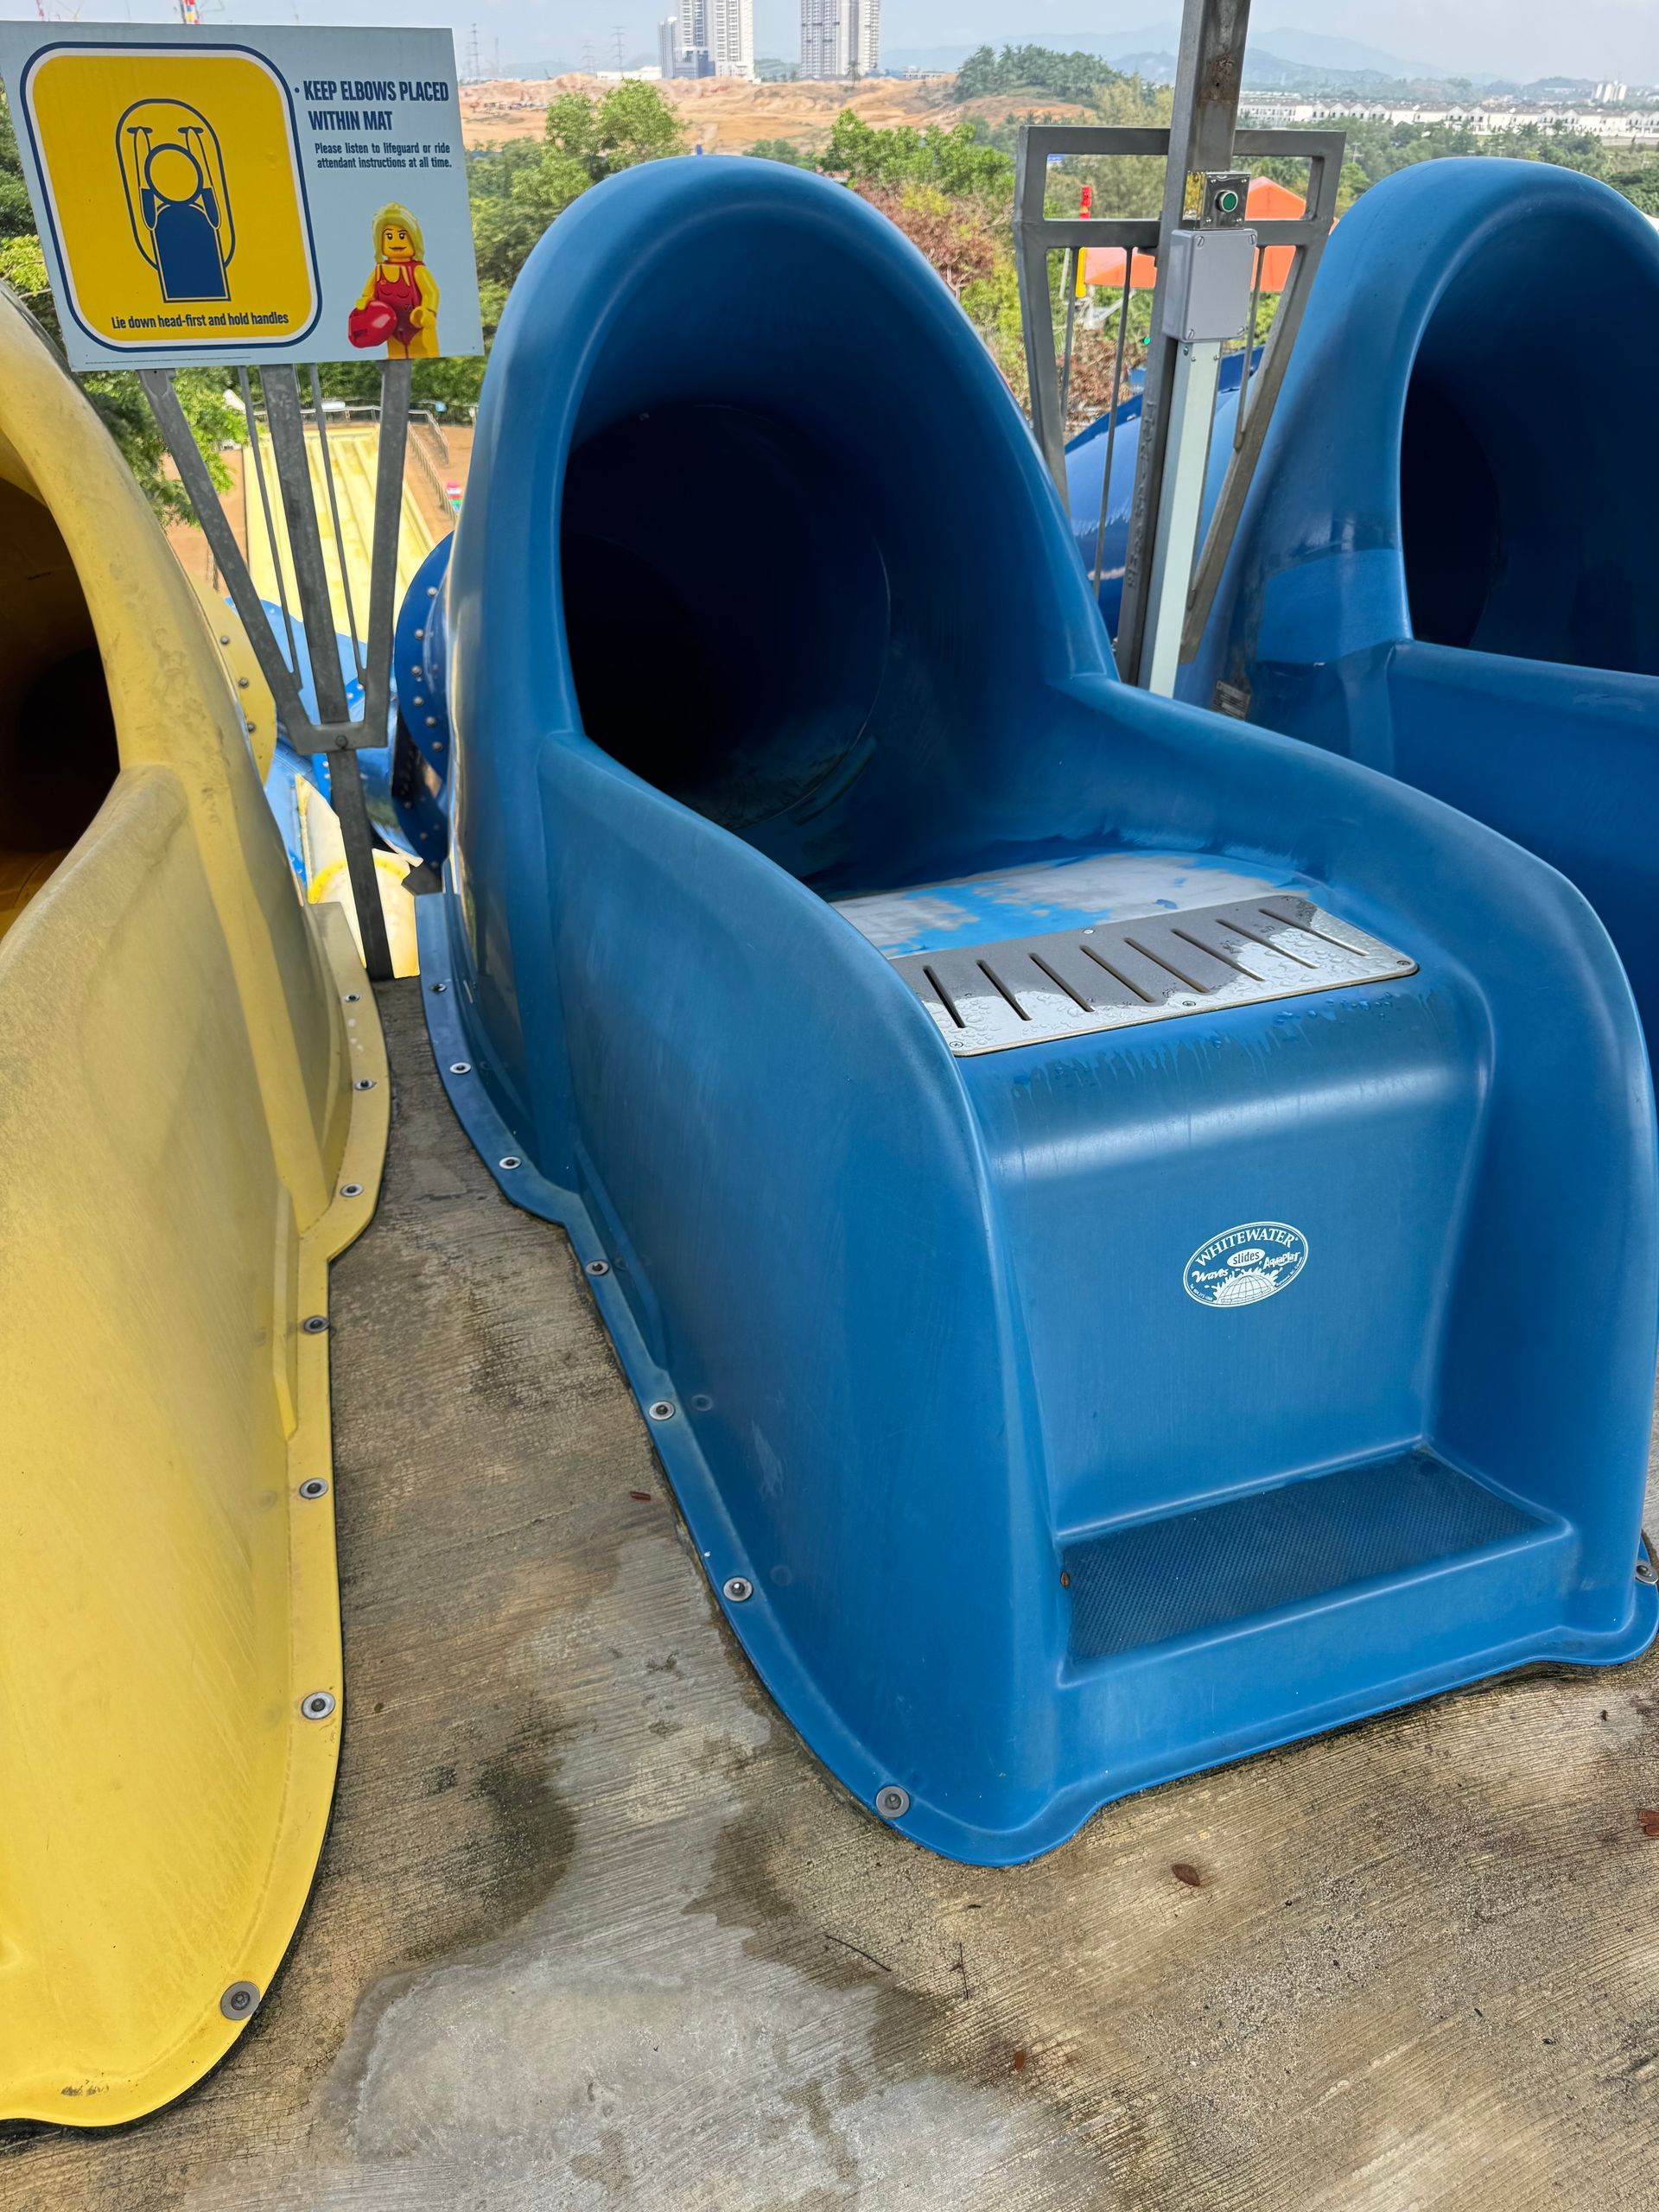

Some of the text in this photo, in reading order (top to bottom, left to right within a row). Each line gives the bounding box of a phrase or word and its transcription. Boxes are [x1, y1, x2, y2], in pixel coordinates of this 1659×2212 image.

[303, 80, 449, 101] KEEP ELBOWS PLACED
[308, 111, 393, 130] WITHIN MAT
[315, 142, 450, 156] Please listen to lifeguard or ride
[317, 156, 452, 168] attendant instructions at all time.
[111, 311, 289, 329] Lie down head-first and hold handles
[1195, 1228, 1295, 1267] WHITEWATER
[1232, 1250, 1260, 1265] slides
